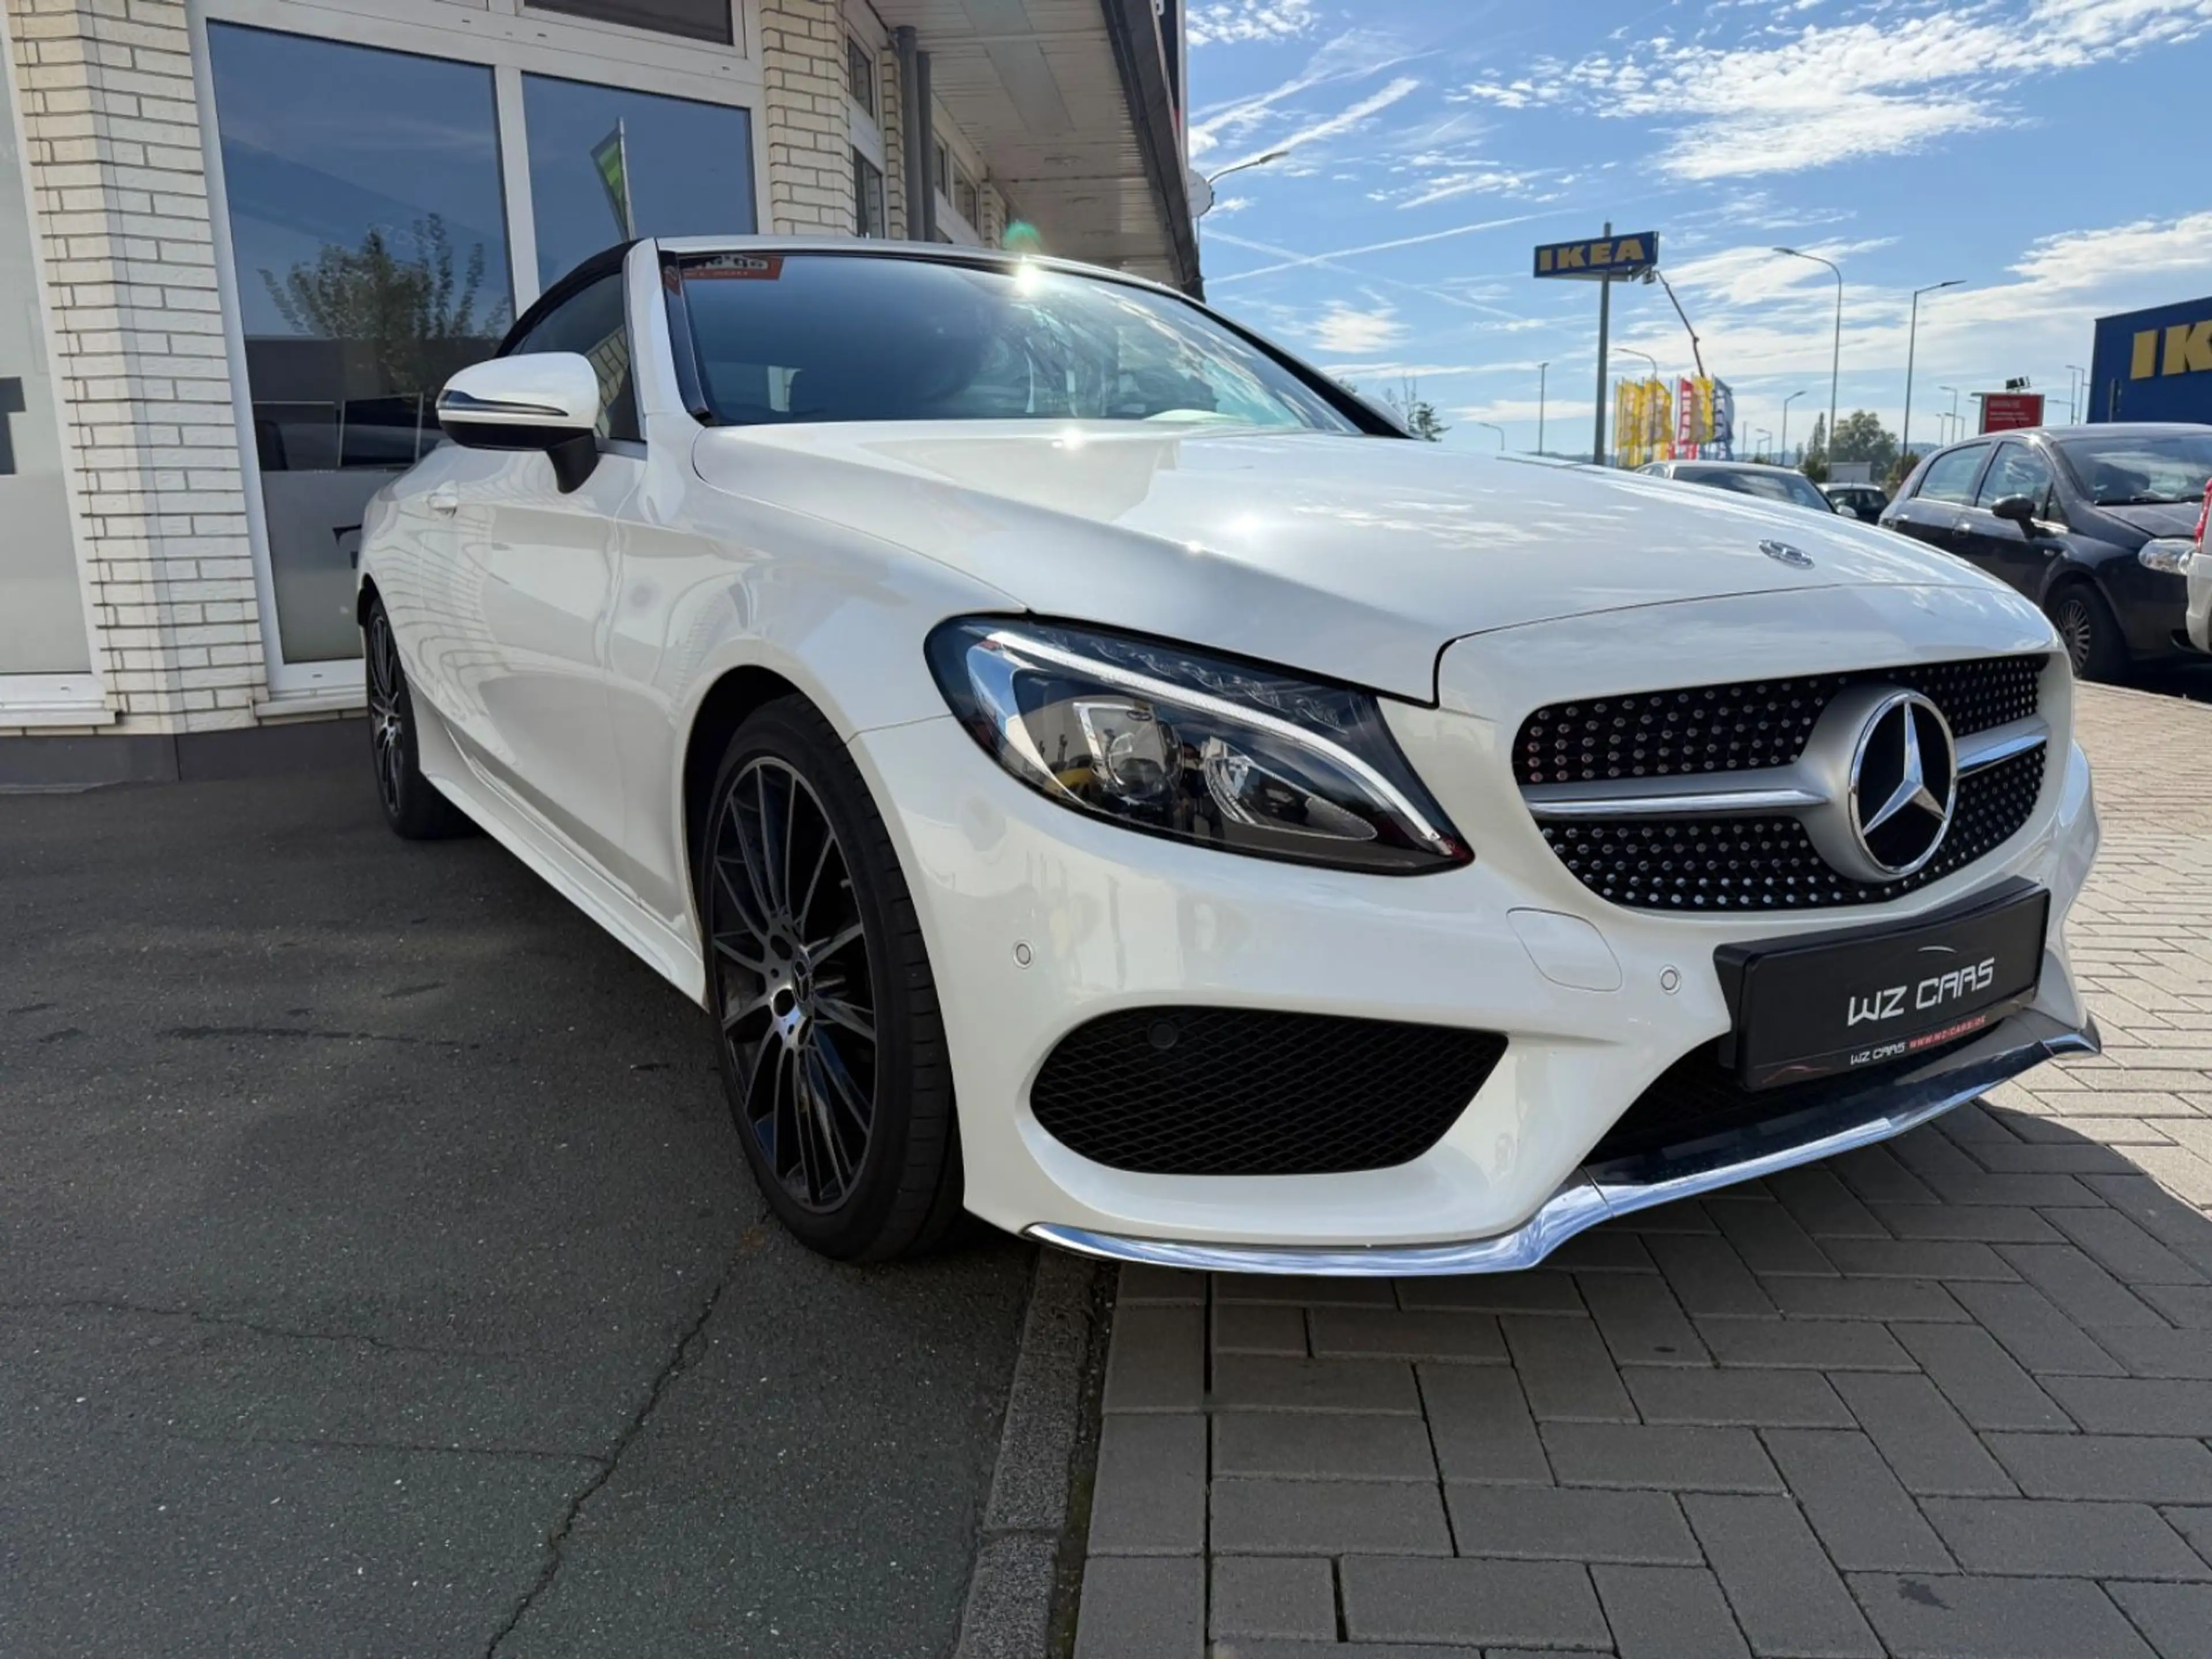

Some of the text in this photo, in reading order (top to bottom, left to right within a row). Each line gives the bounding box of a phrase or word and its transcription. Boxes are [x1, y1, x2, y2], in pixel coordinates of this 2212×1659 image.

[1539, 239, 1645, 271] IKEA
[1847, 986, 1908, 1027] WZ
[1850, 1051, 1870, 1065] WZ
